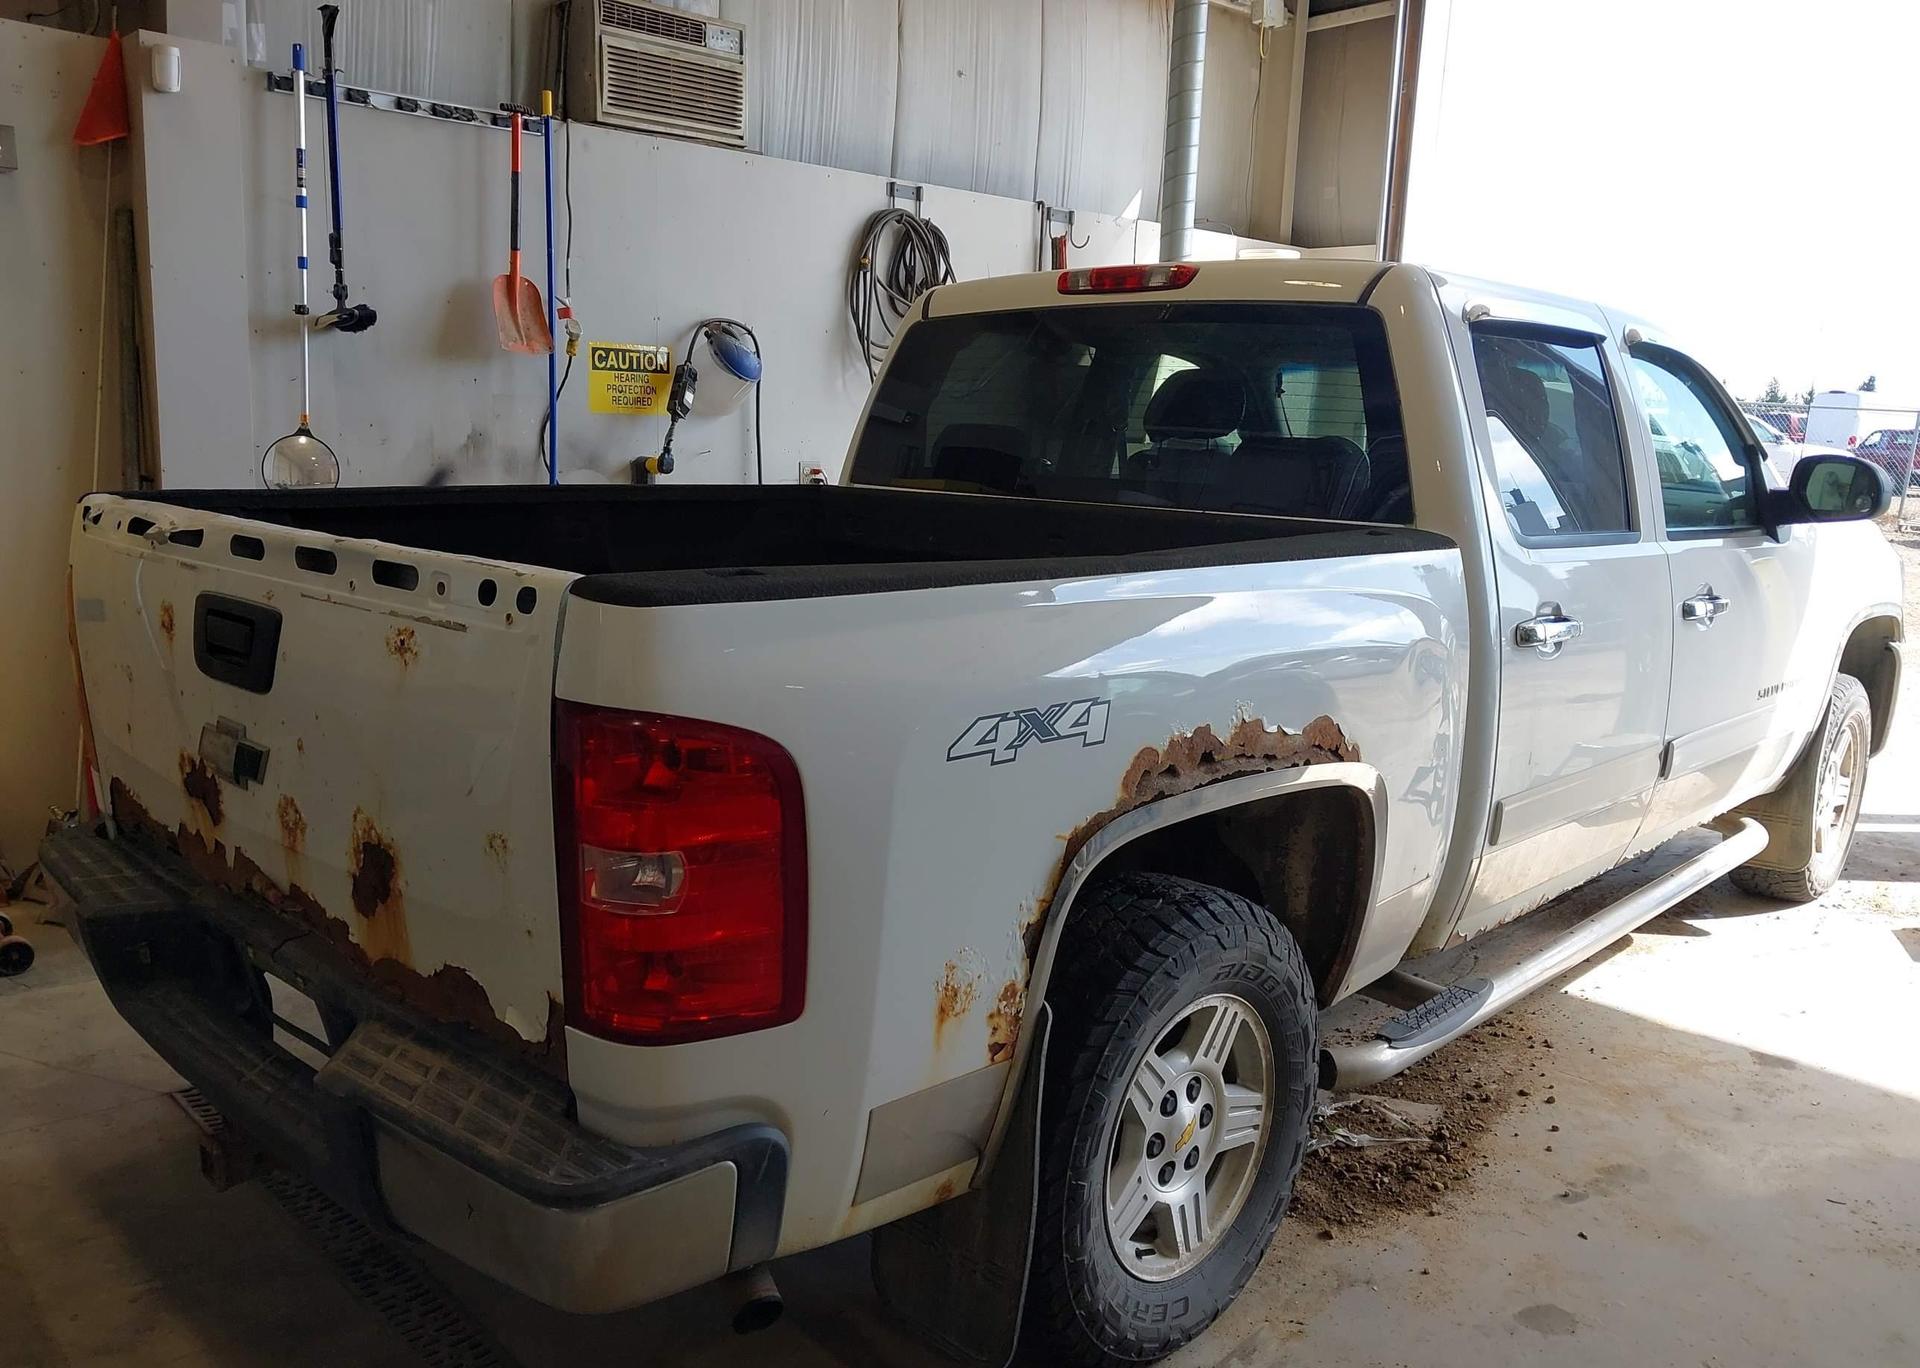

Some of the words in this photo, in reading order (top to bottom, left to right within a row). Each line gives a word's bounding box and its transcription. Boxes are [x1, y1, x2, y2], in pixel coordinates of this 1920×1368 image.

[594, 350, 668, 371] CAUTION
[614, 373, 650, 383] HEARING
[606, 384, 657, 395] PROTECTION
[611, 396, 653, 406] REQUIRED
